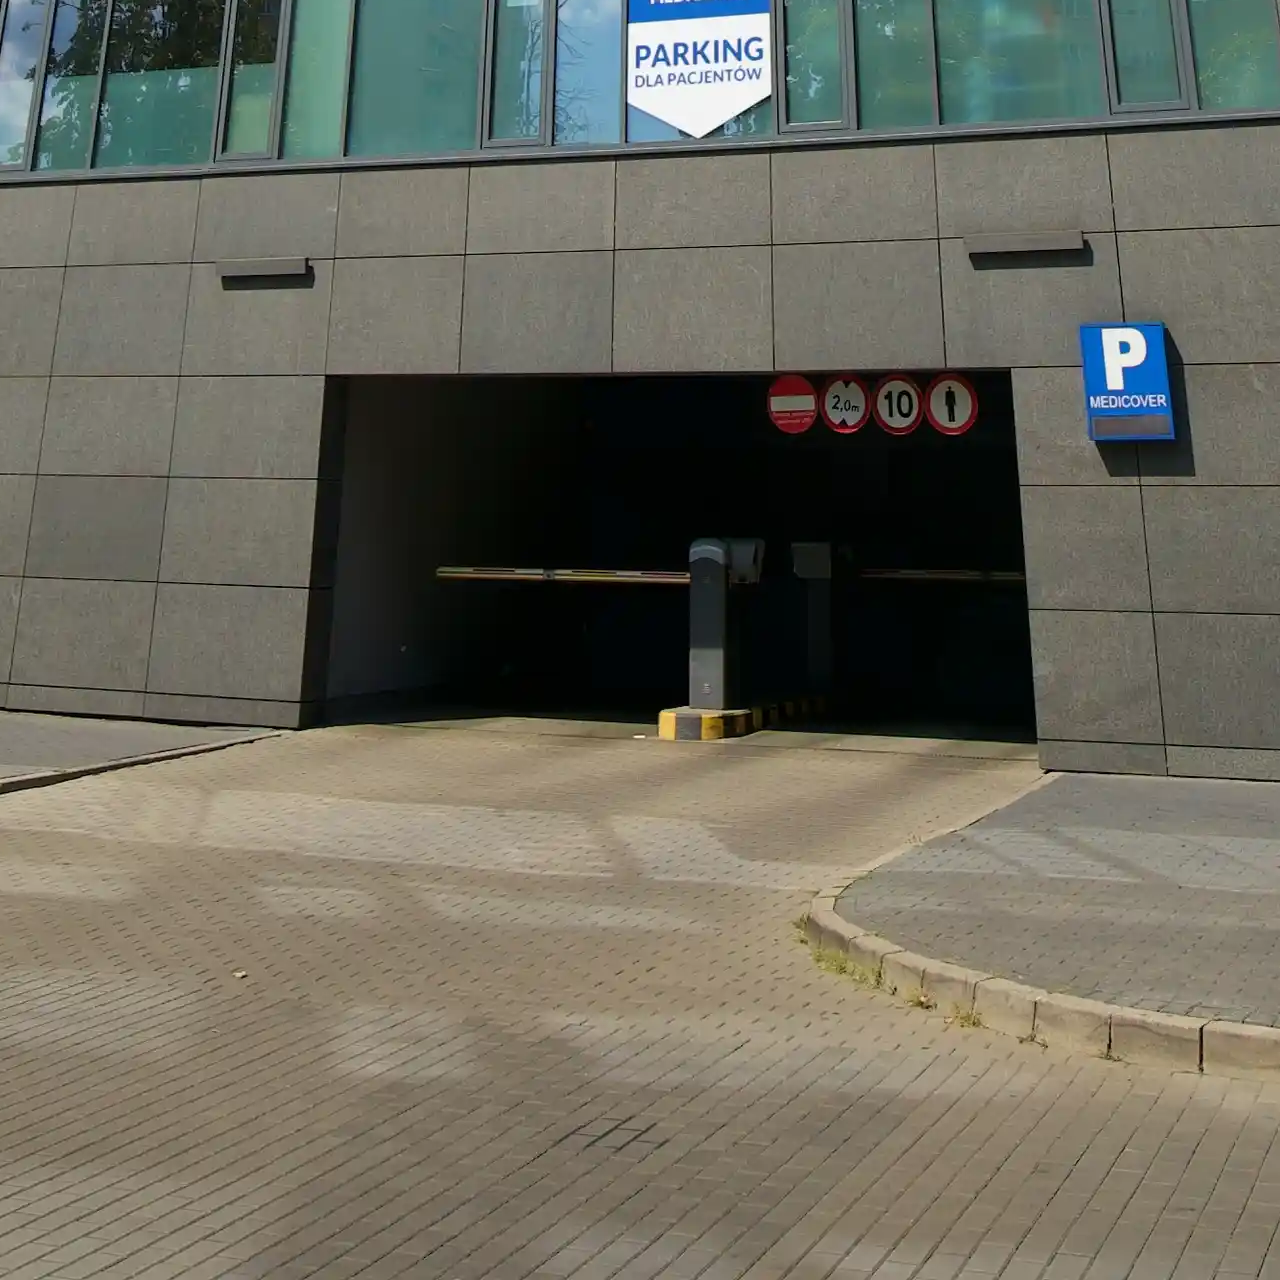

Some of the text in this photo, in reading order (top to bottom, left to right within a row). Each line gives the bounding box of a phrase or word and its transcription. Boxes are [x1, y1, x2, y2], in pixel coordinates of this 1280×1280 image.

[635, 37, 764, 69] PARKING
[635, 66, 762, 88] DLA PACJENTÓW
[1101, 327, 1147, 391] P
[884, 390, 913, 419] 10
[1089, 394, 1168, 409] MEDICOVER
